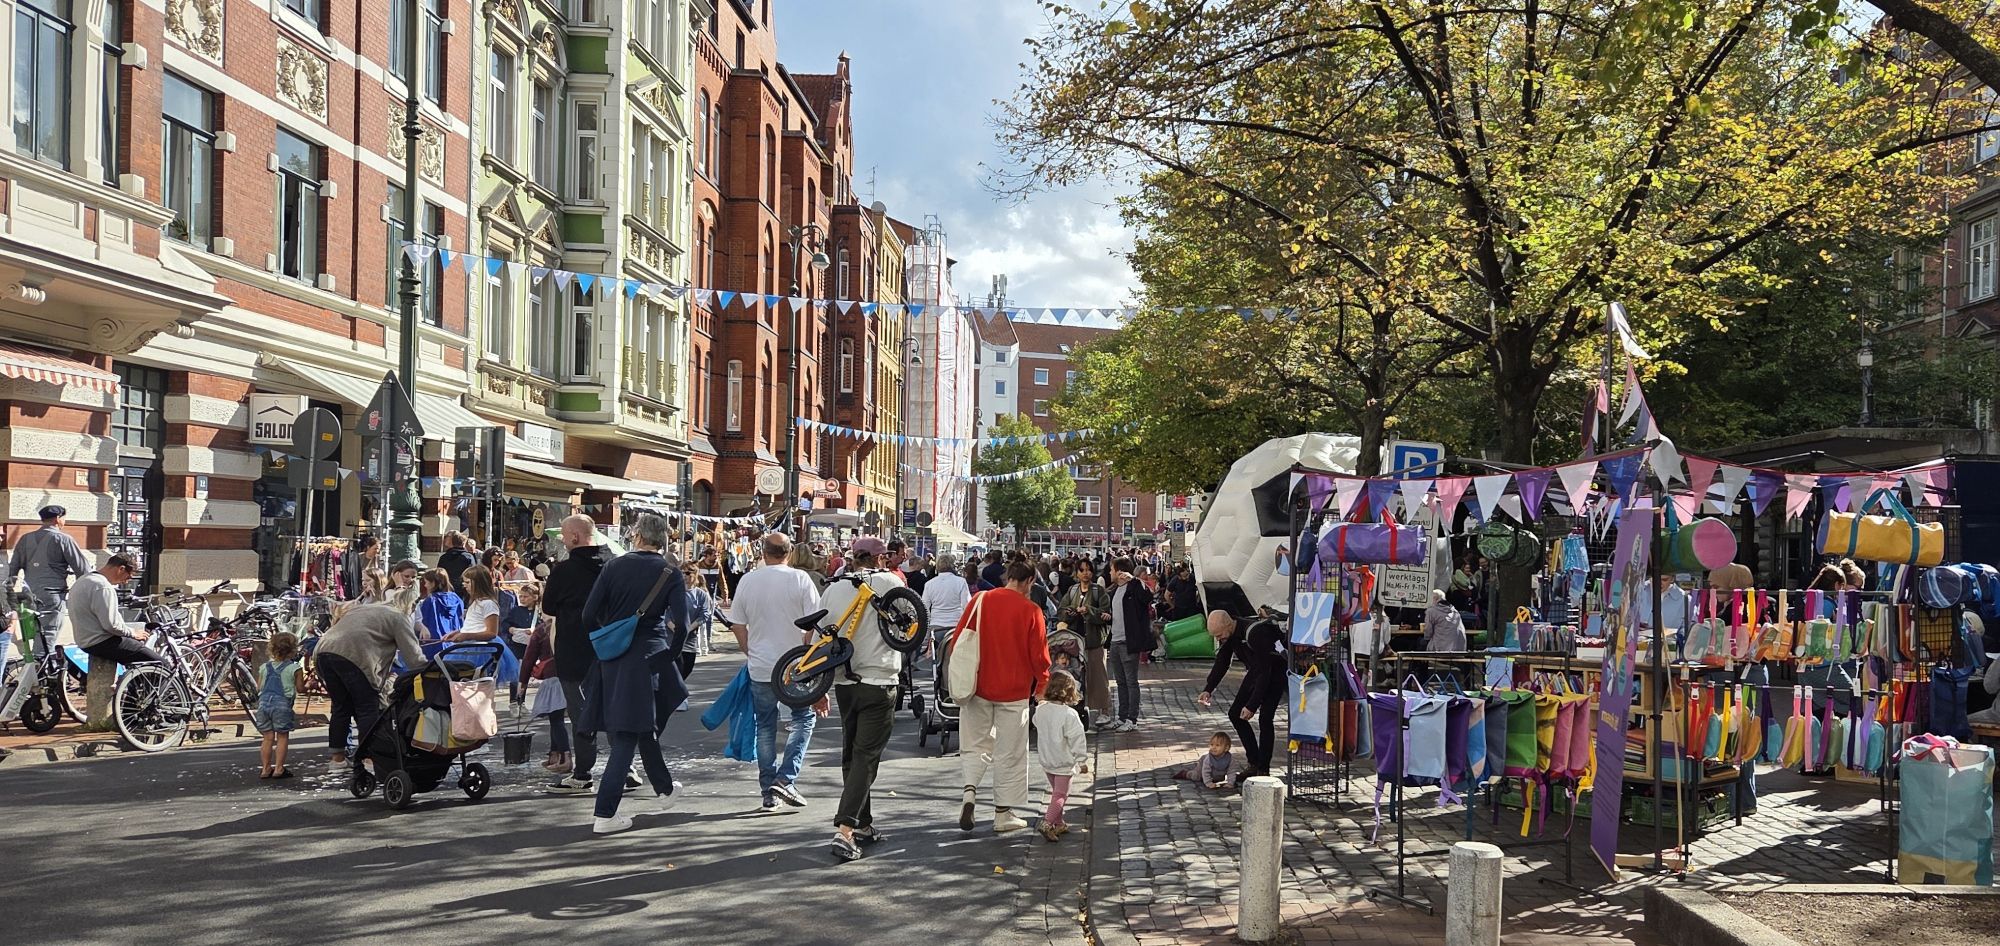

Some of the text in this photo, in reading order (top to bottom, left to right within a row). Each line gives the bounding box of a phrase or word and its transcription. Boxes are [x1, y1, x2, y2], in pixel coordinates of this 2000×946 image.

[1402, 451, 1428, 480] P
[1175, 522, 1182, 531] P
[1388, 573, 1426, 584] werktags
[9, 686, 28, 711] Lime
